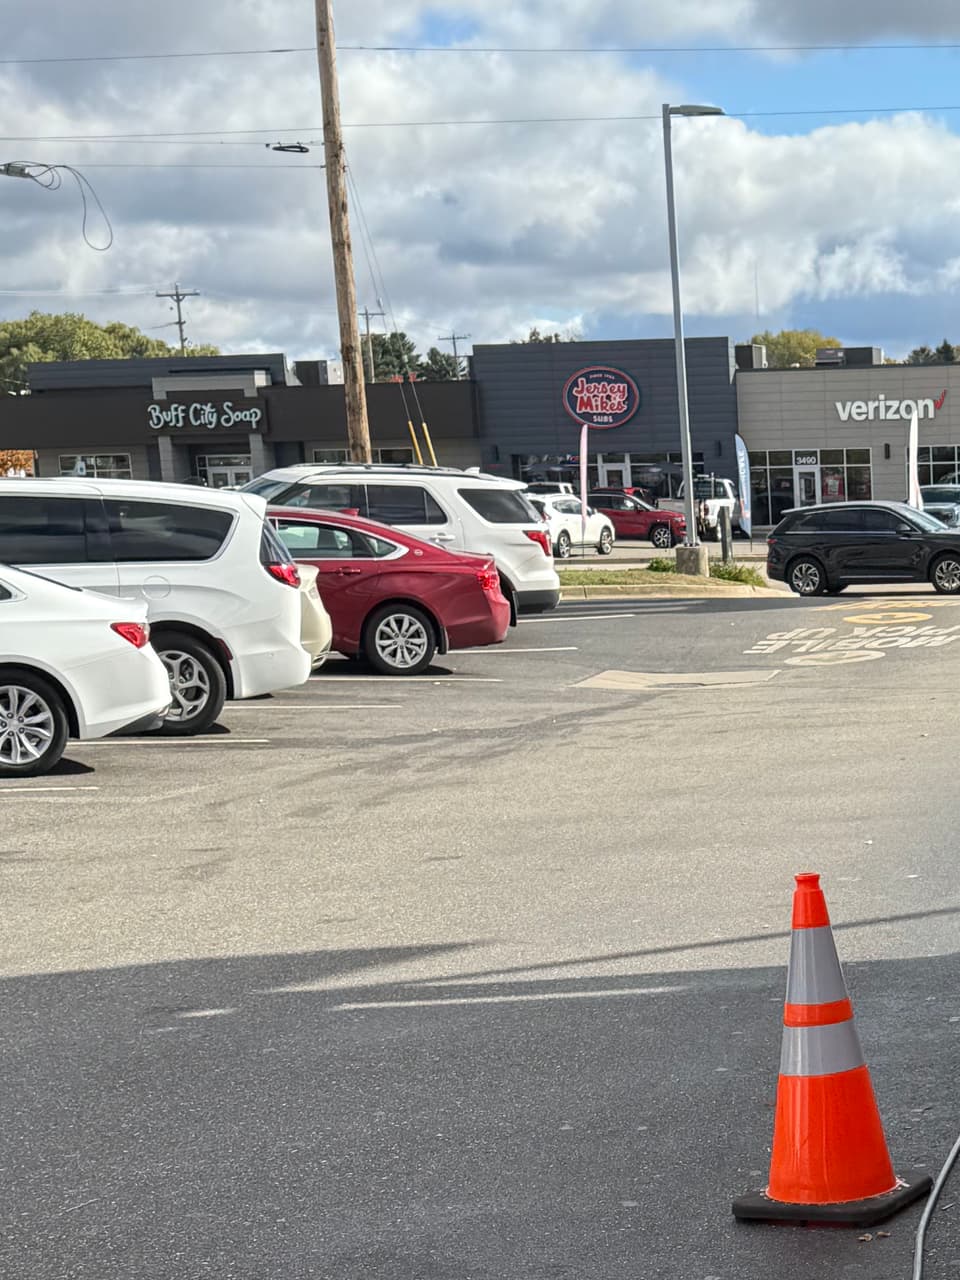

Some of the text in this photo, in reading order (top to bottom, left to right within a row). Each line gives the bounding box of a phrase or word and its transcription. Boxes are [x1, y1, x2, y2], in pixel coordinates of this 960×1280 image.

[572, 377, 628, 400] Jersey
[147, 401, 262, 429] Buff City Soap
[834, 393, 935, 421] verizon
[796, 456, 817, 465] 3490
[766, 627, 837, 640] UP
